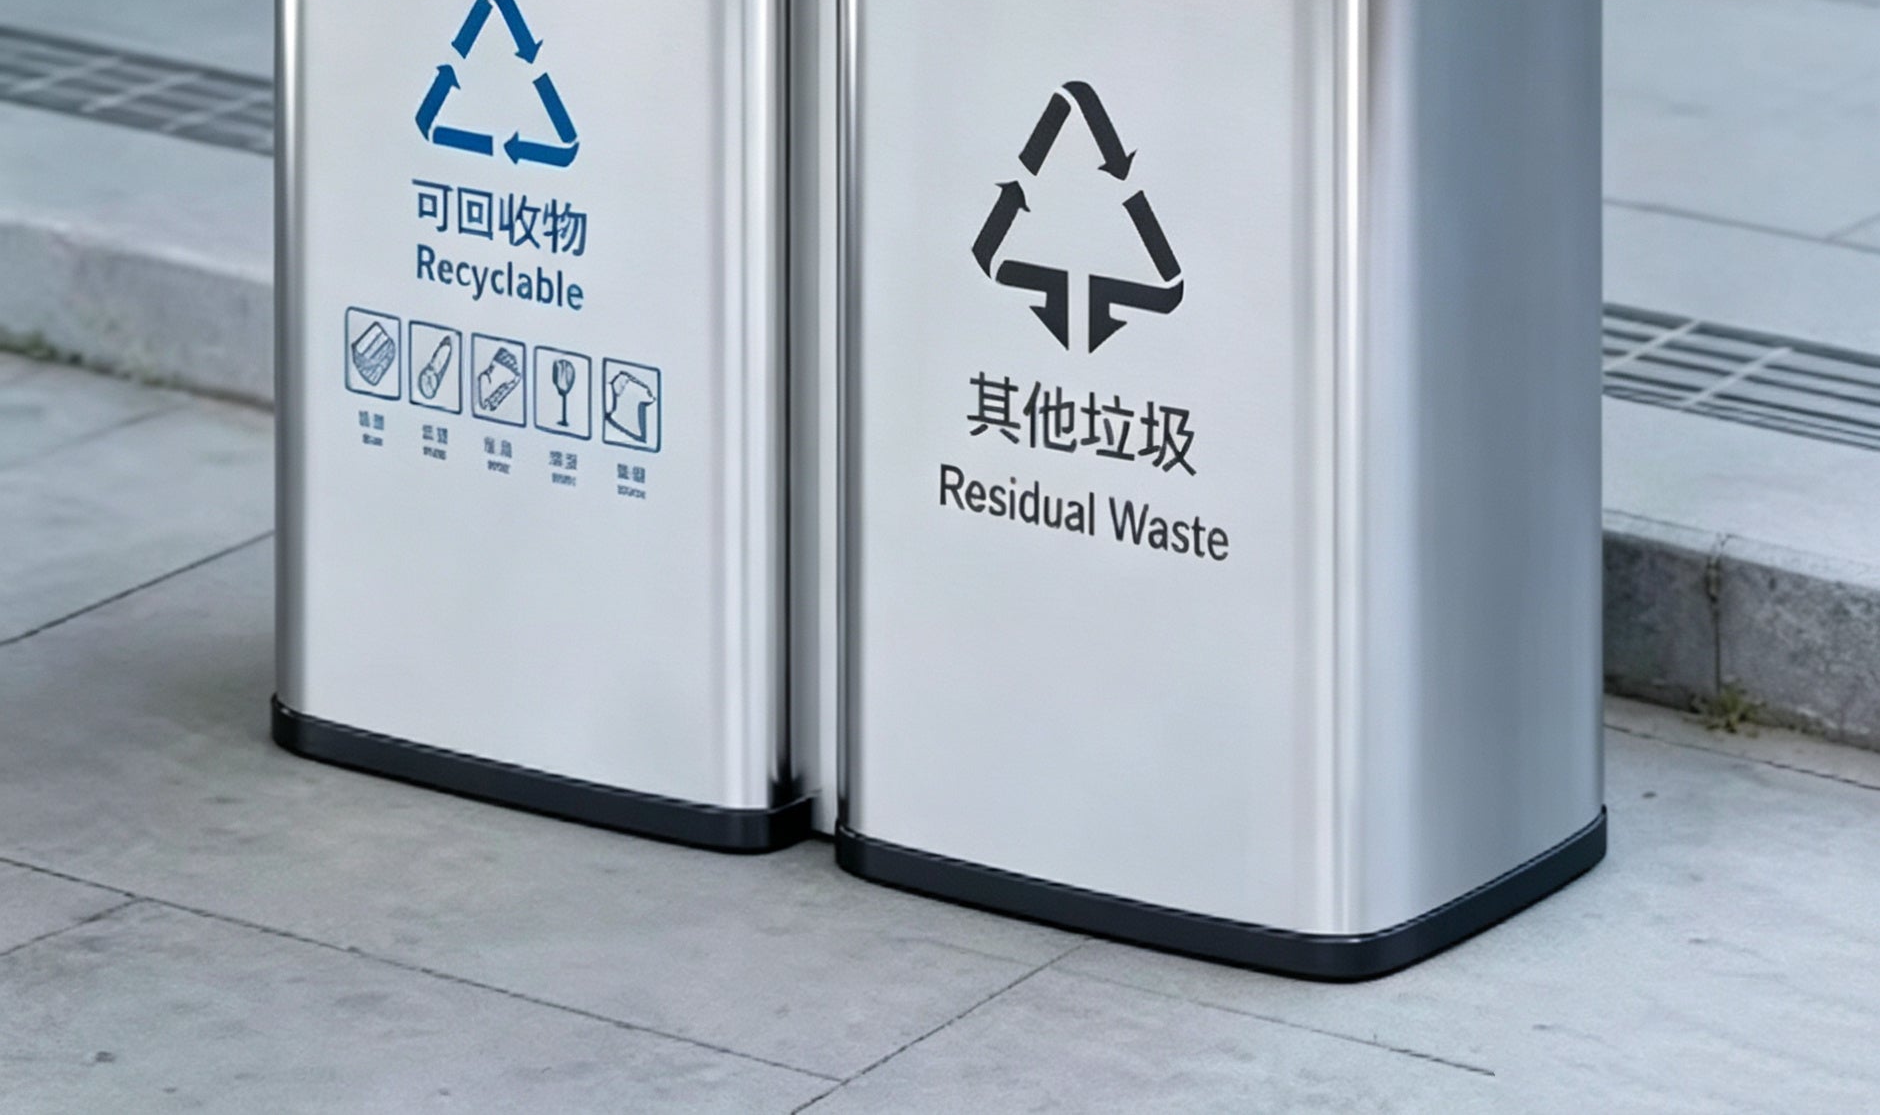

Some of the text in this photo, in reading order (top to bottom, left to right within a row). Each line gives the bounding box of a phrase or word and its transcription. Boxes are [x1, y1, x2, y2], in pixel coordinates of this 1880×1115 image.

[411, 178, 588, 257] 可回收物
[416, 243, 585, 312] Recyclable
[966, 370, 1198, 477] 其他垃圾
[939, 462, 1230, 562] Residual Waste
